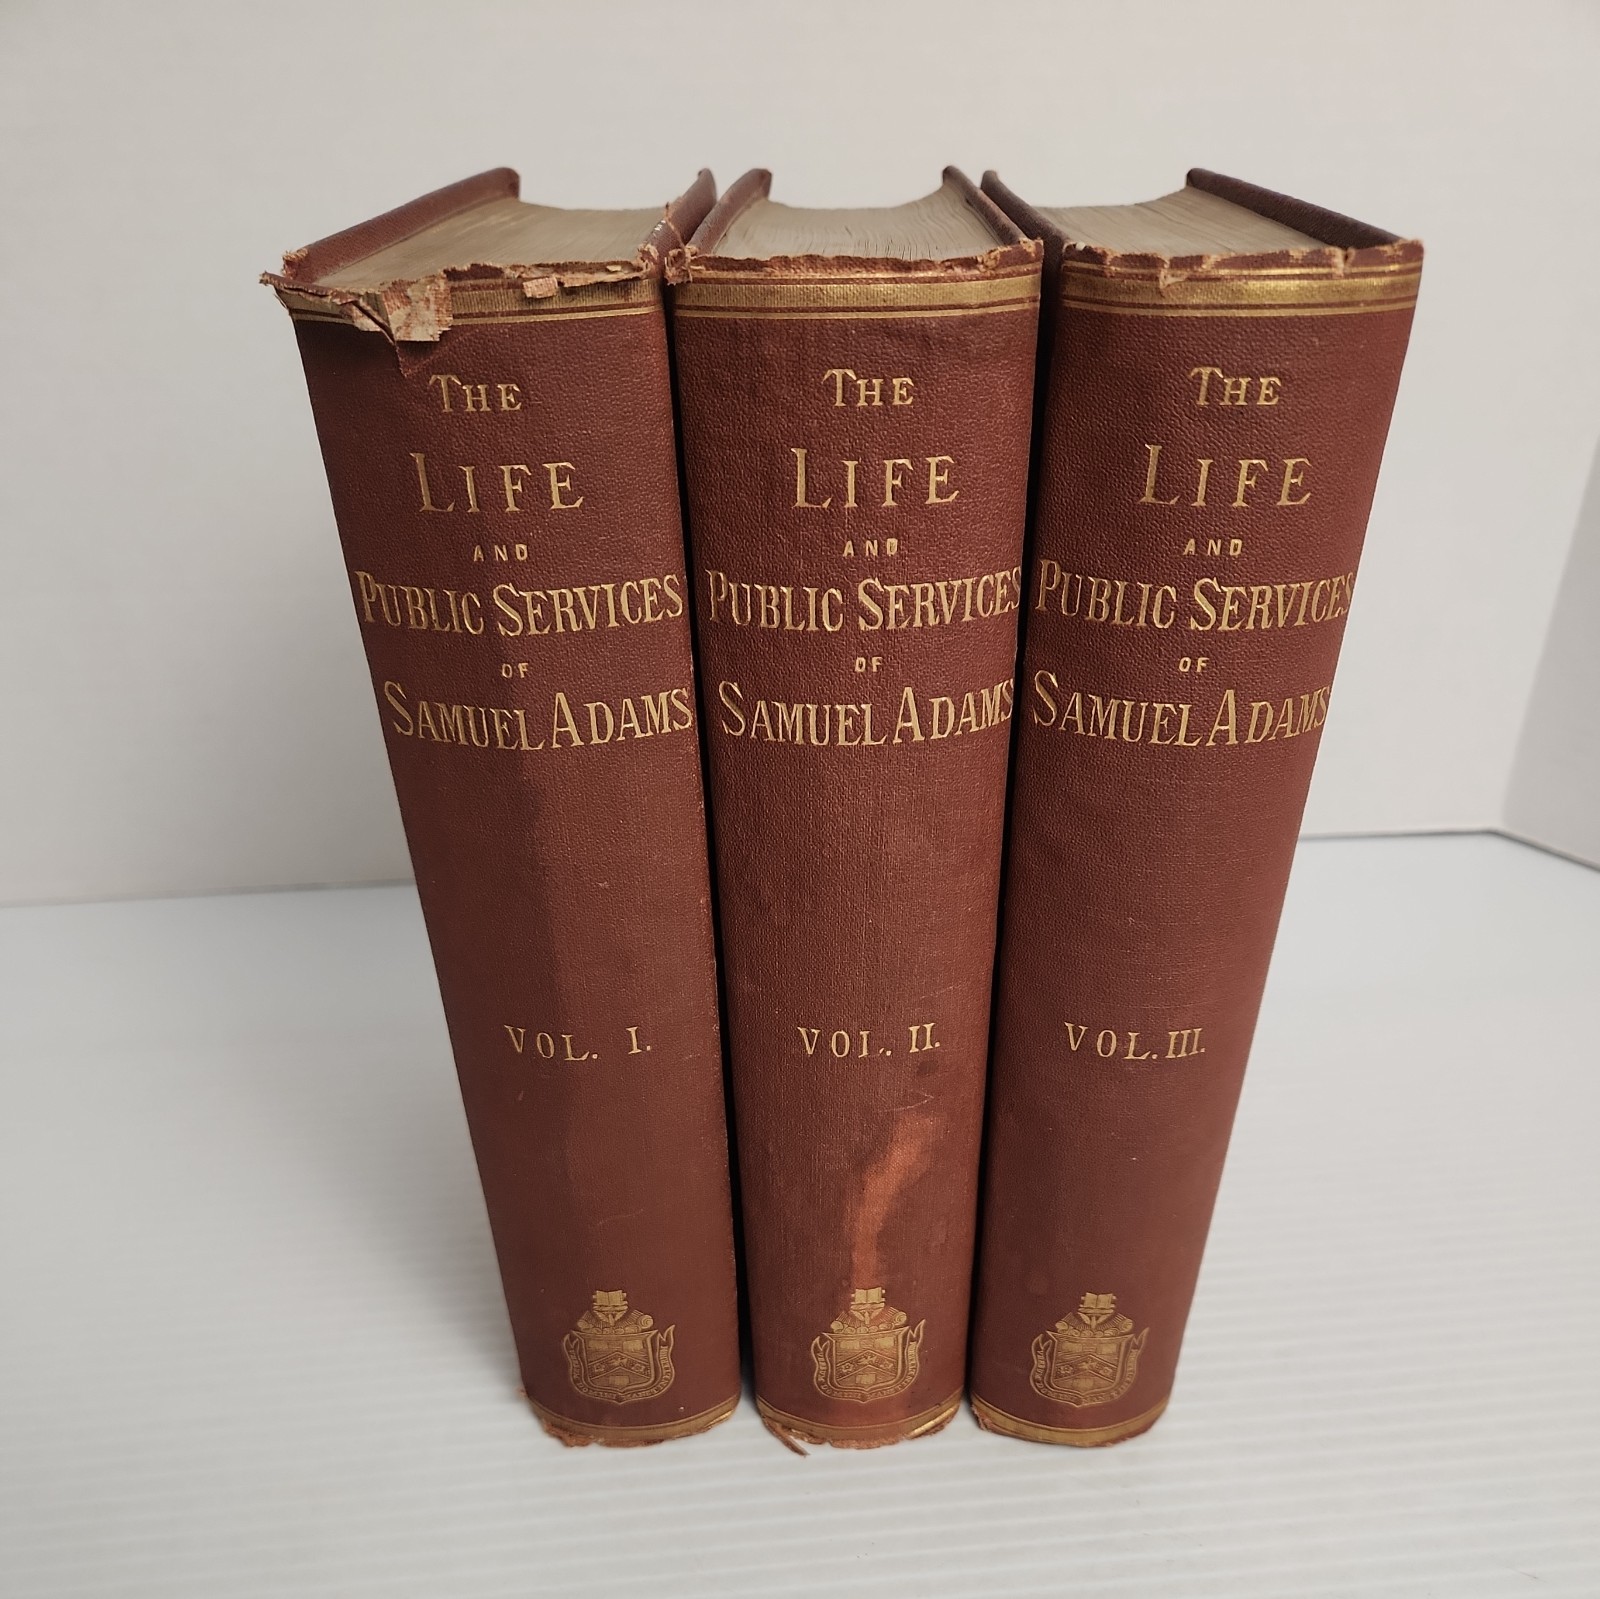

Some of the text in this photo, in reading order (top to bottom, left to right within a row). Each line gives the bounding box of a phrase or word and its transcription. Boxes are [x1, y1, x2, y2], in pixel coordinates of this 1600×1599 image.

[429, 374, 522, 412] THE
[822, 369, 914, 407] THE
[1190, 367, 1282, 406] THE
[410, 452, 584, 513] LIFE
[791, 447, 960, 508] LIFE
[1139, 444, 1312, 507] LIFE
[473, 543, 528, 561] AND
[843, 538, 898, 557] AND
[1183, 538, 1242, 557] AND
[355, 570, 683, 636] PUBLIC SERVICES
[706, 566, 1021, 632] PUBLIC SERVICES
[1036, 559, 1353, 631] PUBLIC SERVICES
[502, 662, 529, 678] OF
[854, 657, 882, 672] OF
[1179, 657, 1209, 672] OF
[384, 680, 692, 751] SAMUEL ADAMS
[719, 679, 1014, 746] SAMUEL ADAMS
[1033, 670, 1329, 746] SAMUEL ADAMS
[504, 1025, 651, 1061] VOL. I.
[908, 1022, 940, 1053] II.
[1064, 1022, 1205, 1060] VOL. III.
